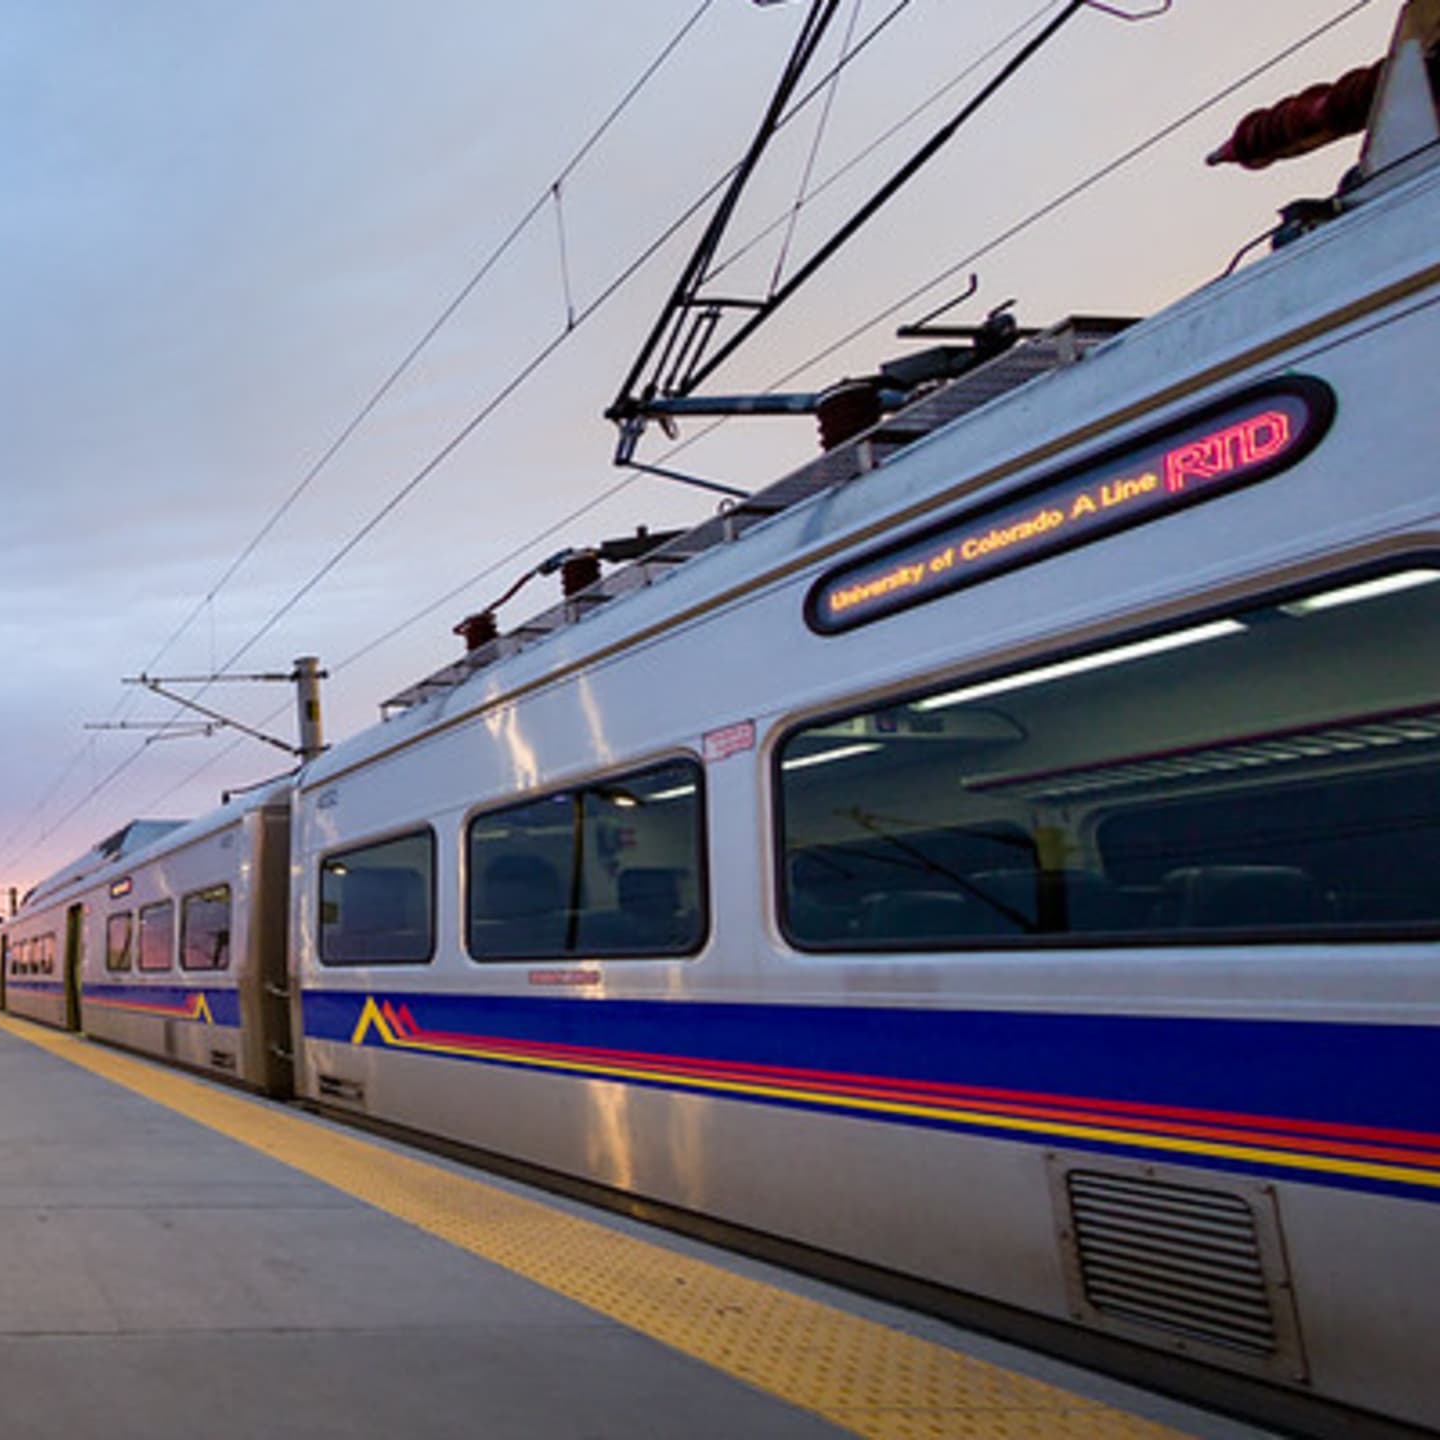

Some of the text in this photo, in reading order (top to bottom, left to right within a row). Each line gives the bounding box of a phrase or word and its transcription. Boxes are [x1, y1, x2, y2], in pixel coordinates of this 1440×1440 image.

[830, 409, 1291, 610] University of Colorado A Line RTD
